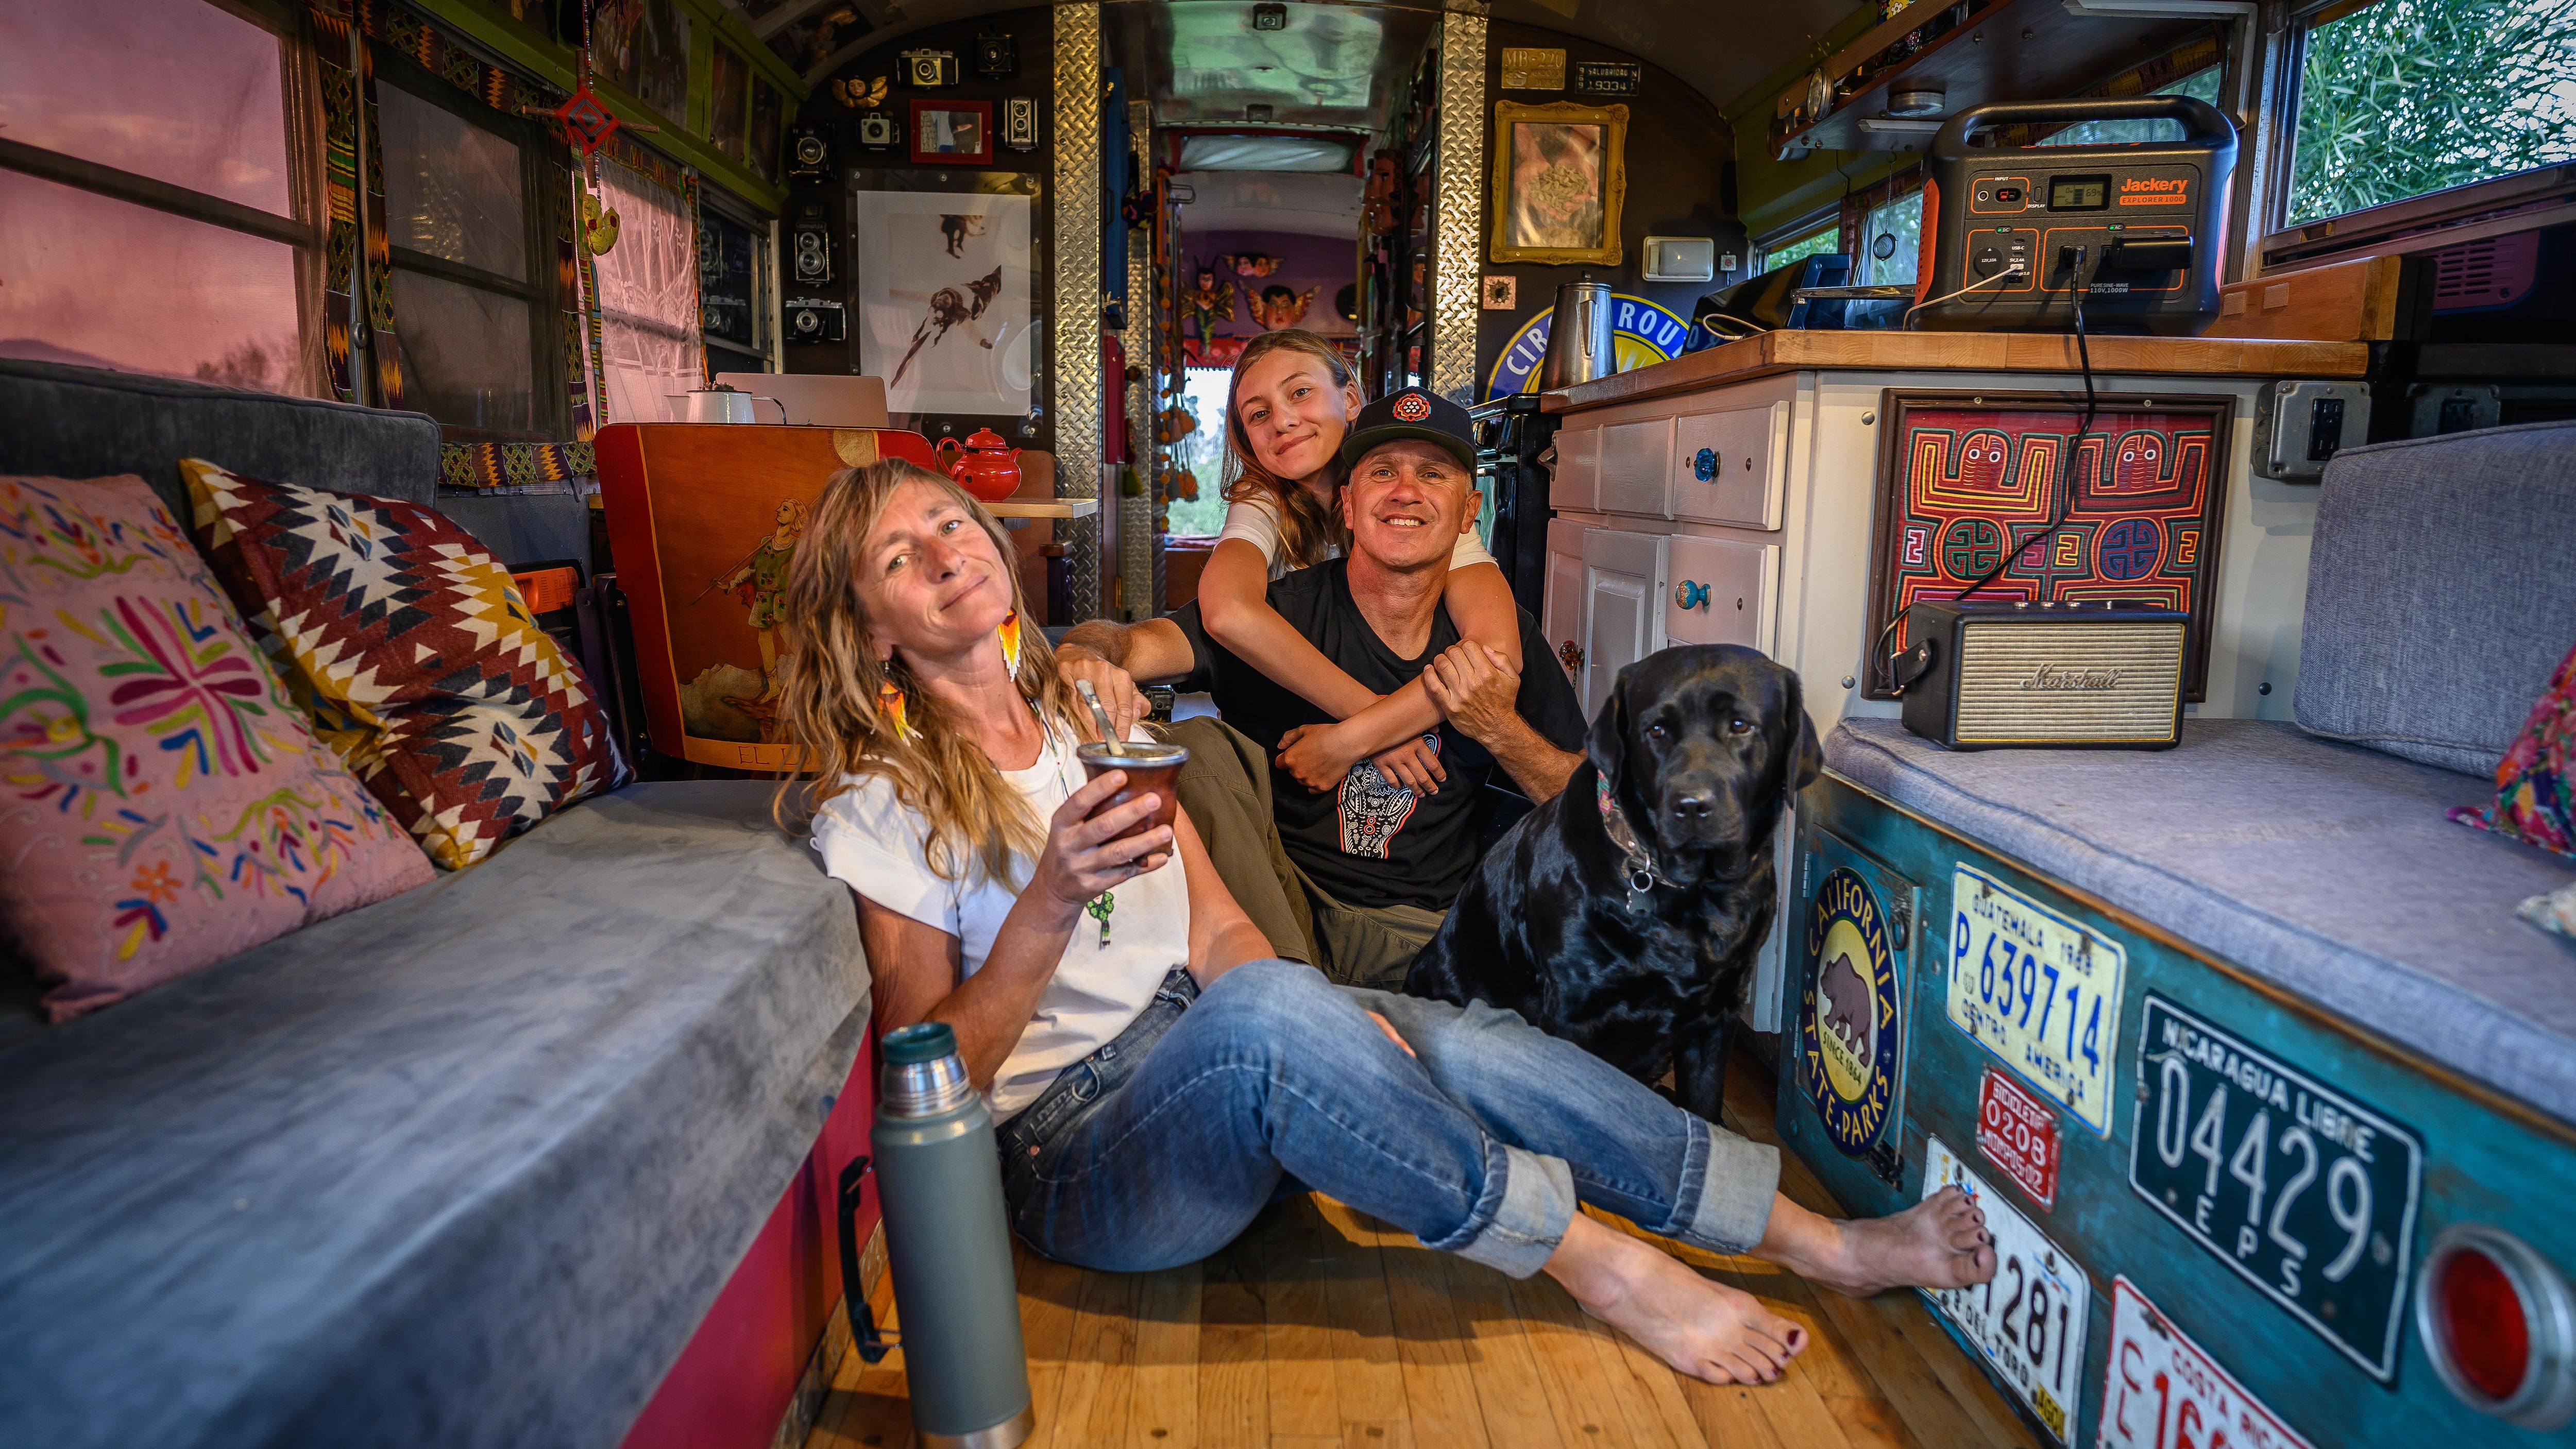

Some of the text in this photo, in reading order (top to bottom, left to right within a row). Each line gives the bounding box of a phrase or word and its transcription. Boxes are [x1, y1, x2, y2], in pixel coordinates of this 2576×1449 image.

[2121, 178, 2188, 194] Jackery
[1506, 315, 1553, 376] CIR
[2020, 662, 2123, 689] Marshall
[738, 745, 770, 766] EL
[1809, 878, 1894, 1030] CALIFORNIA
[1972, 893, 2044, 951] GUATEMALA
[1954, 910, 2102, 1078] P 639714
[1803, 989, 1888, 1147] STATE PARKS
[1823, 1031, 1862, 1086] SINCE 1864
[1961, 998, 2085, 1101] CENTRO AMERICA
[2162, 1017, 2376, 1164] NICARAGUA LIBRE
[1986, 1098, 2046, 1167] 0208
[2157, 1056, 2372, 1283] 04429
[2172, 1348, 2228, 1418] COSTA
